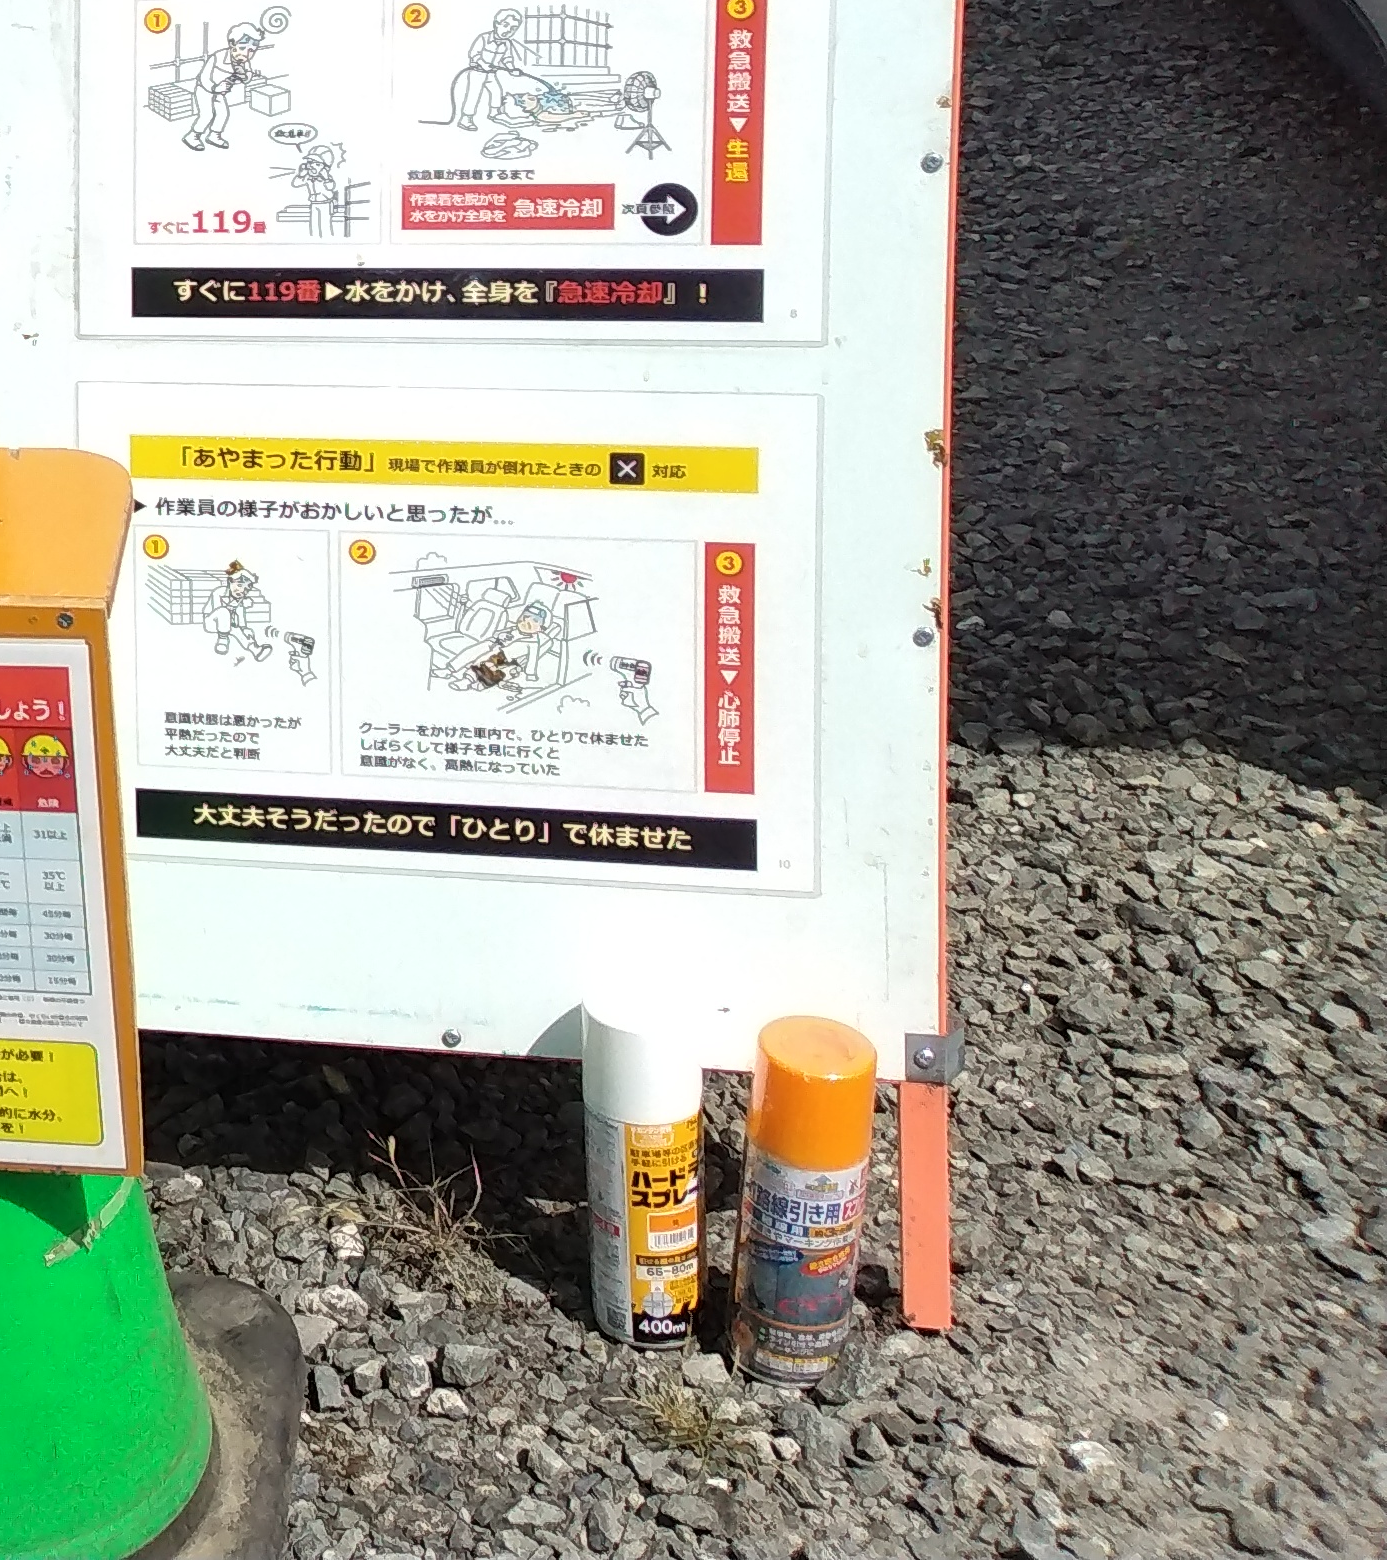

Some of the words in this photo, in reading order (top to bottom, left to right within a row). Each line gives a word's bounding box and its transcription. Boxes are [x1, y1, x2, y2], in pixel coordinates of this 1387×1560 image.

[408, 208, 507, 223] 水をかけ全身を
[513, 197, 603, 219] 急速冷却
[181, 446, 375, 473] 「あやまった行動」
[652, 464, 687, 479] 対応
[717, 584, 741, 666] 救急搬送
[164, 728, 260, 744] 平熱だったので
[717, 690, 741, 766] 心肺停止
[164, 744, 261, 761] 大丈夫だと判断
[359, 738, 560, 760] しばらくして様子を見に行くと
[37, 798, 59, 808] 危険
[779, 859, 791, 869] 10
[639, 1319, 685, 1334] 400ml
